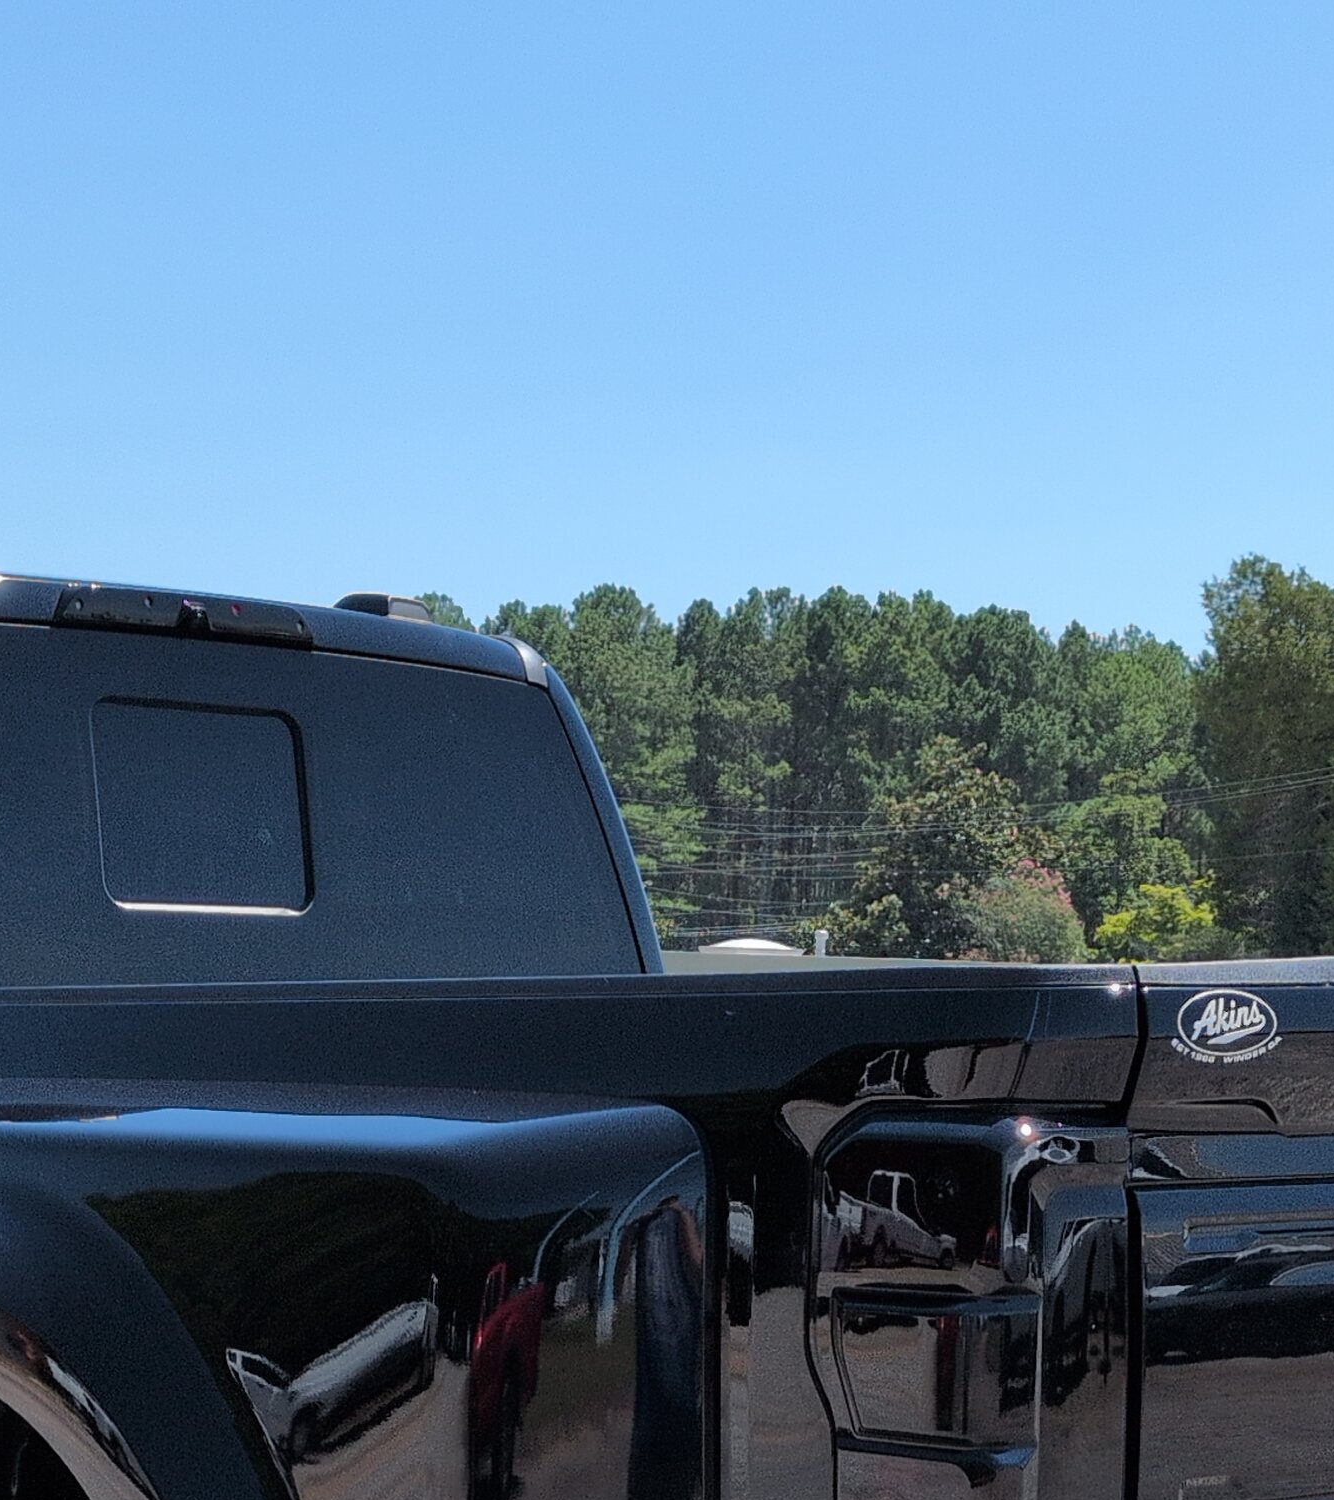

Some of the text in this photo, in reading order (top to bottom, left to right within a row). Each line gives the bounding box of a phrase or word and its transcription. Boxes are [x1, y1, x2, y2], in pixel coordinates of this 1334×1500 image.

[1190, 996, 1267, 1043] Akins
[1222, 1046, 1267, 1064] WINDER
[1267, 1035, 1283, 1050] GA
